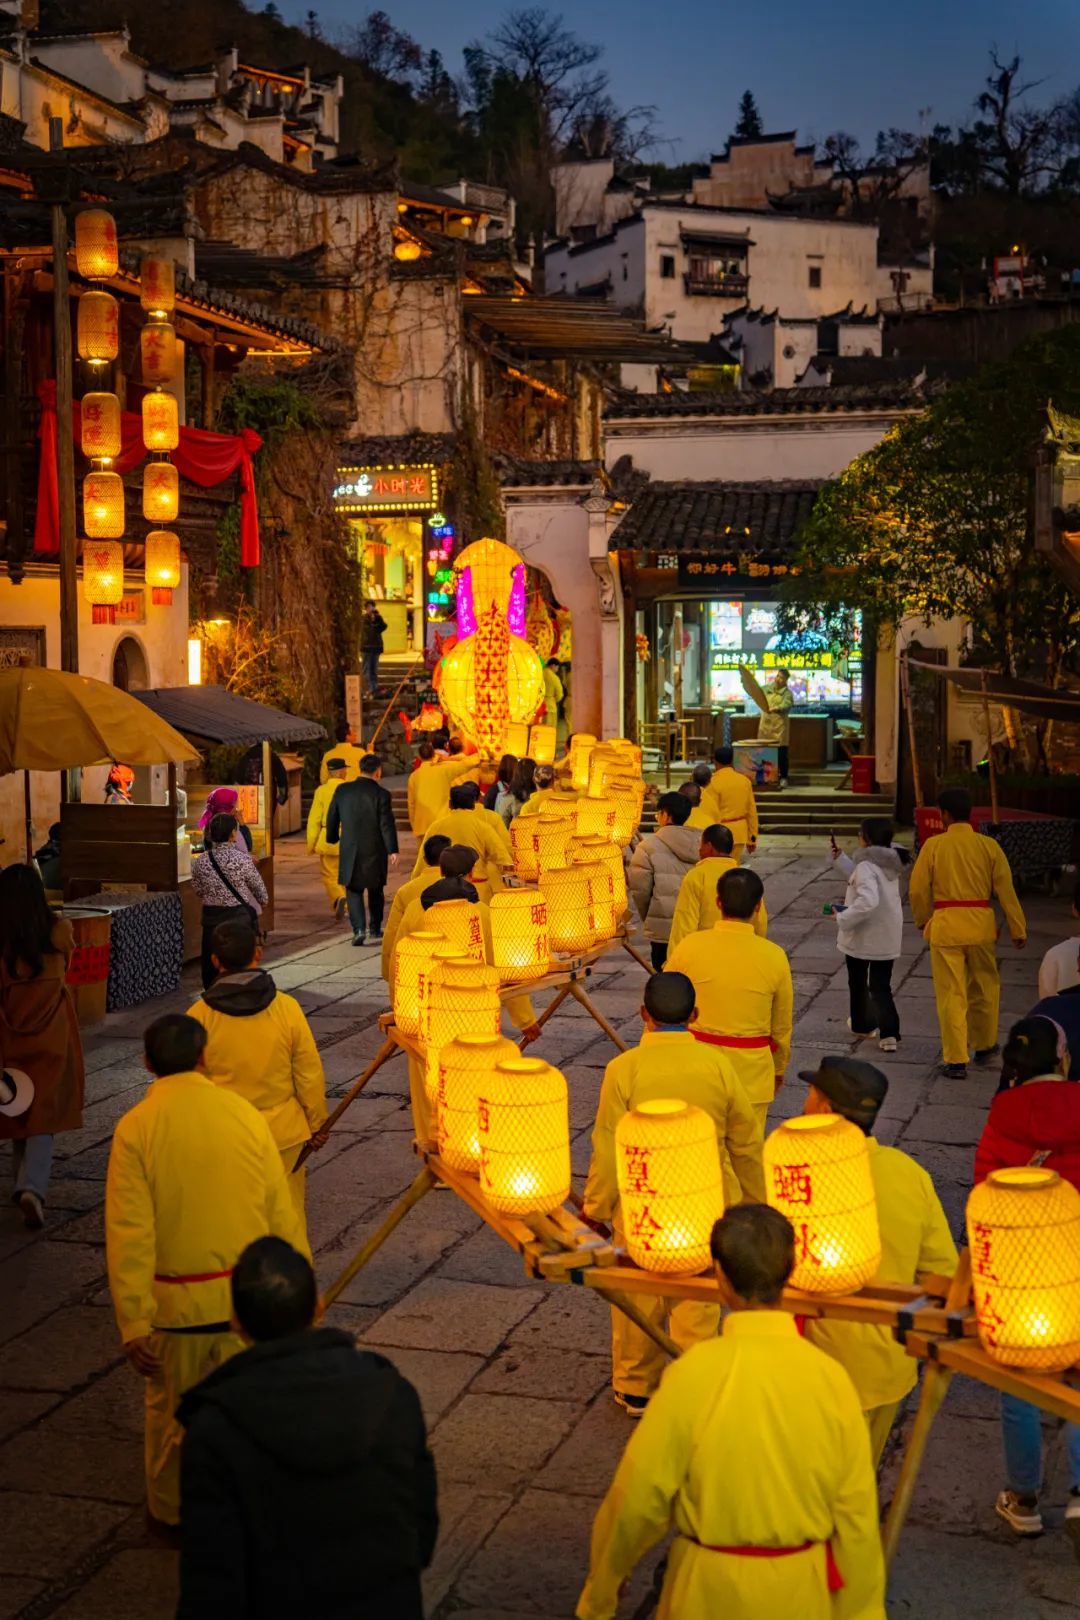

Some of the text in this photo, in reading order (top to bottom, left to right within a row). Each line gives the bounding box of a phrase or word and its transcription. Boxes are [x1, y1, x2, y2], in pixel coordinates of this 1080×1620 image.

[145, 331, 165, 369] 大吉
[374, 476, 426, 496] 小时光
